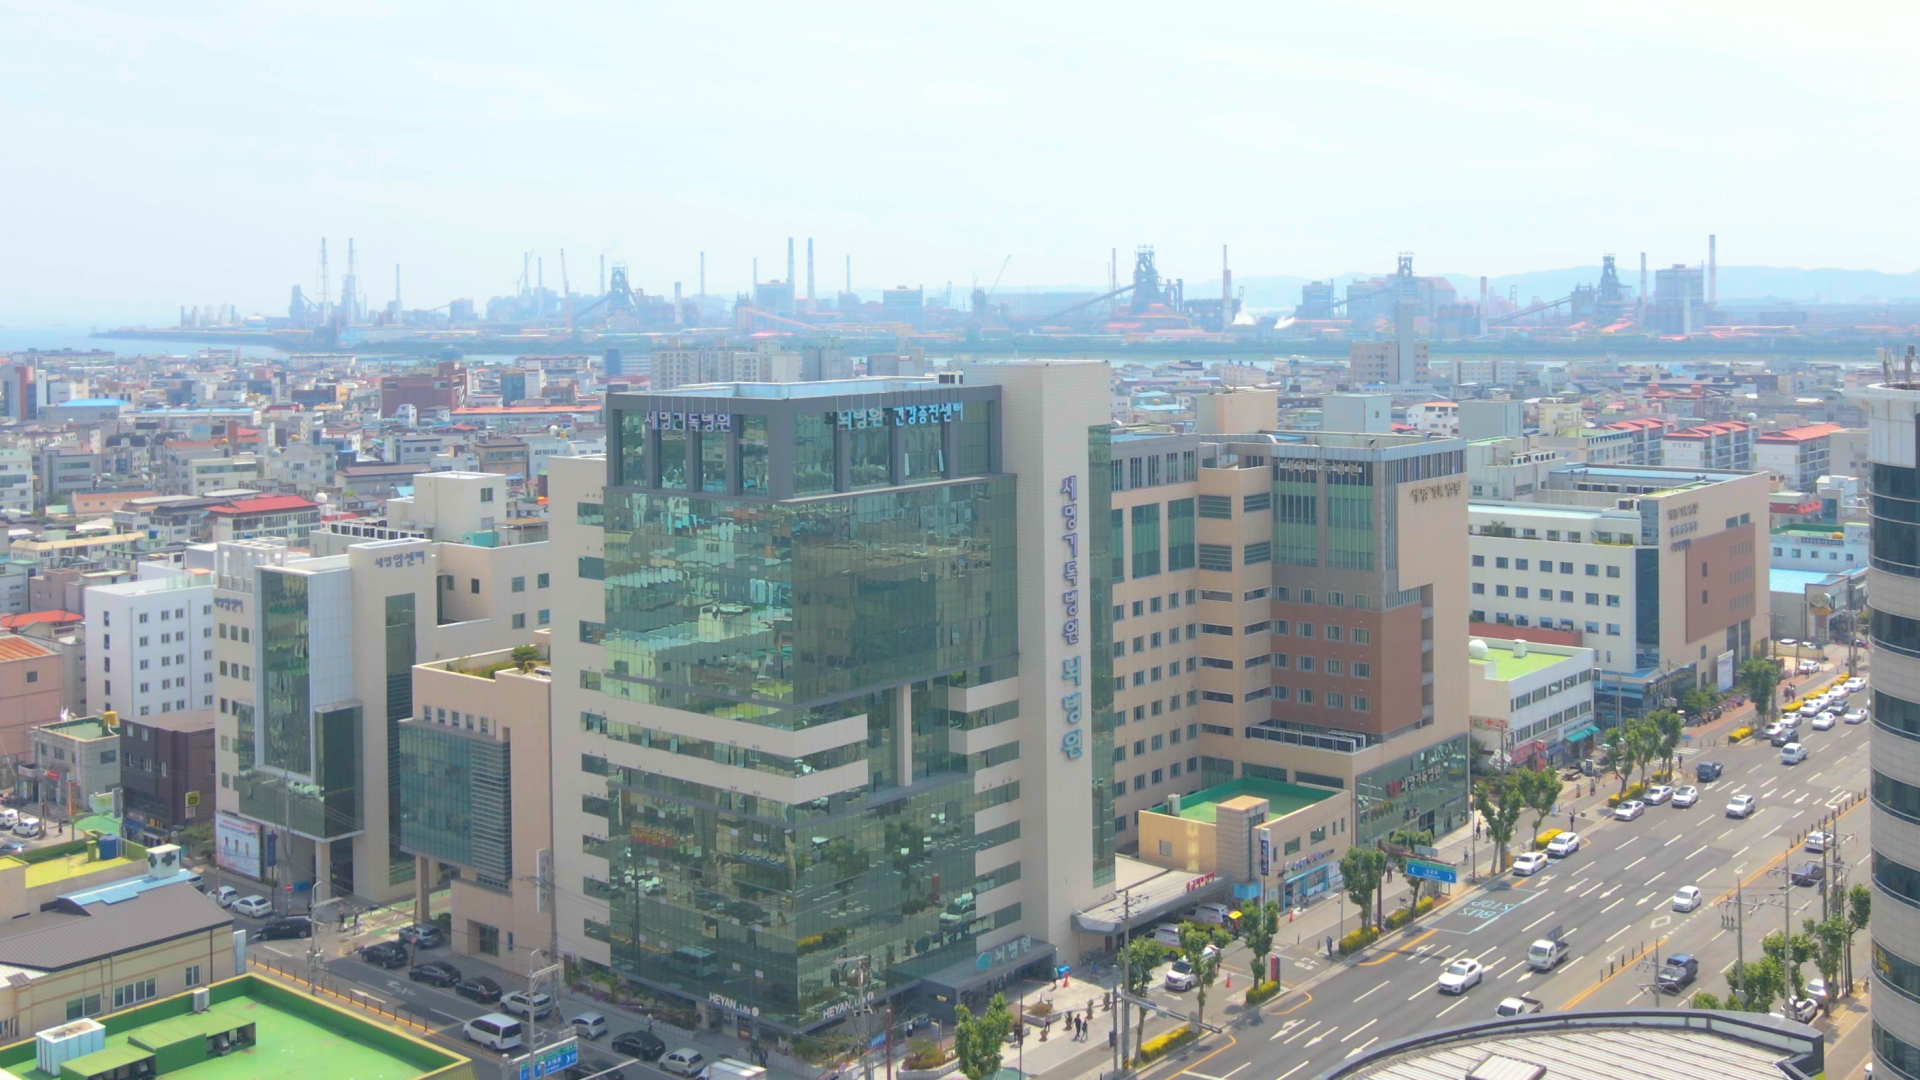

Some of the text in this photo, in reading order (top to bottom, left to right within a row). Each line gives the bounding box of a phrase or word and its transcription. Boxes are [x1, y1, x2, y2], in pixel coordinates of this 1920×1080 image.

[645, 410, 731, 433] 세명기독병원
[837, 401, 963, 431] 뇌병원 건강증진센터
[374, 551, 425, 568] 세명암센터
[1061, 475, 1083, 759] 세명기독병원 뇌병원
[995, 935, 1031, 962] 뇌병원
